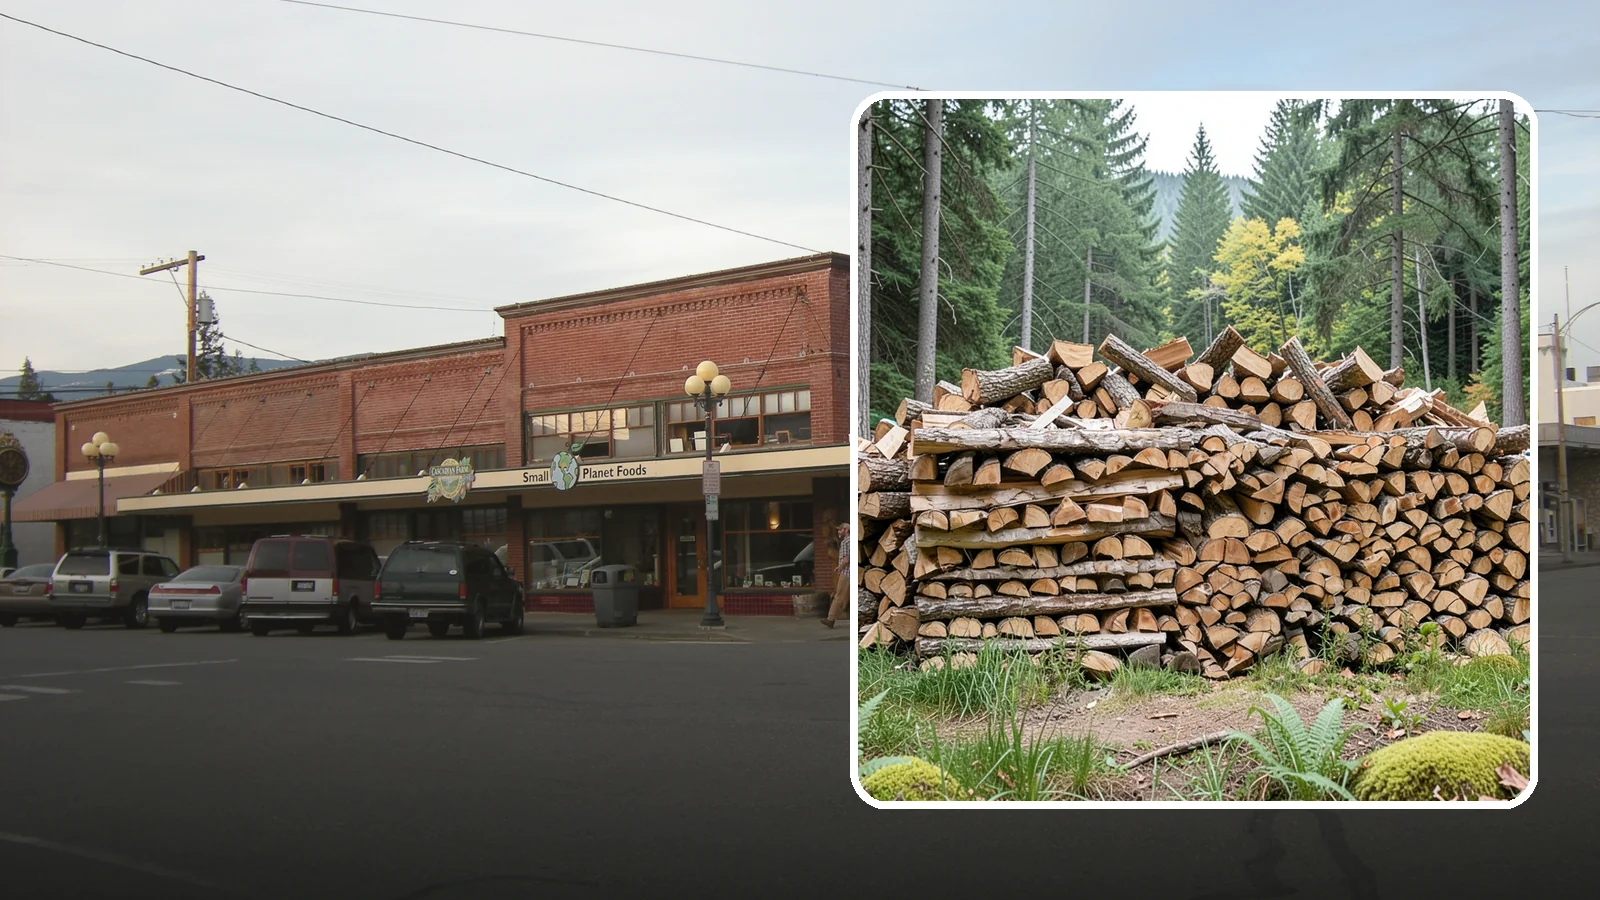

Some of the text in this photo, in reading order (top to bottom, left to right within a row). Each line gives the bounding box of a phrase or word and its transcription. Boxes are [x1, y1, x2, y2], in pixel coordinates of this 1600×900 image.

[522, 463, 647, 483] Small Planet Foods
